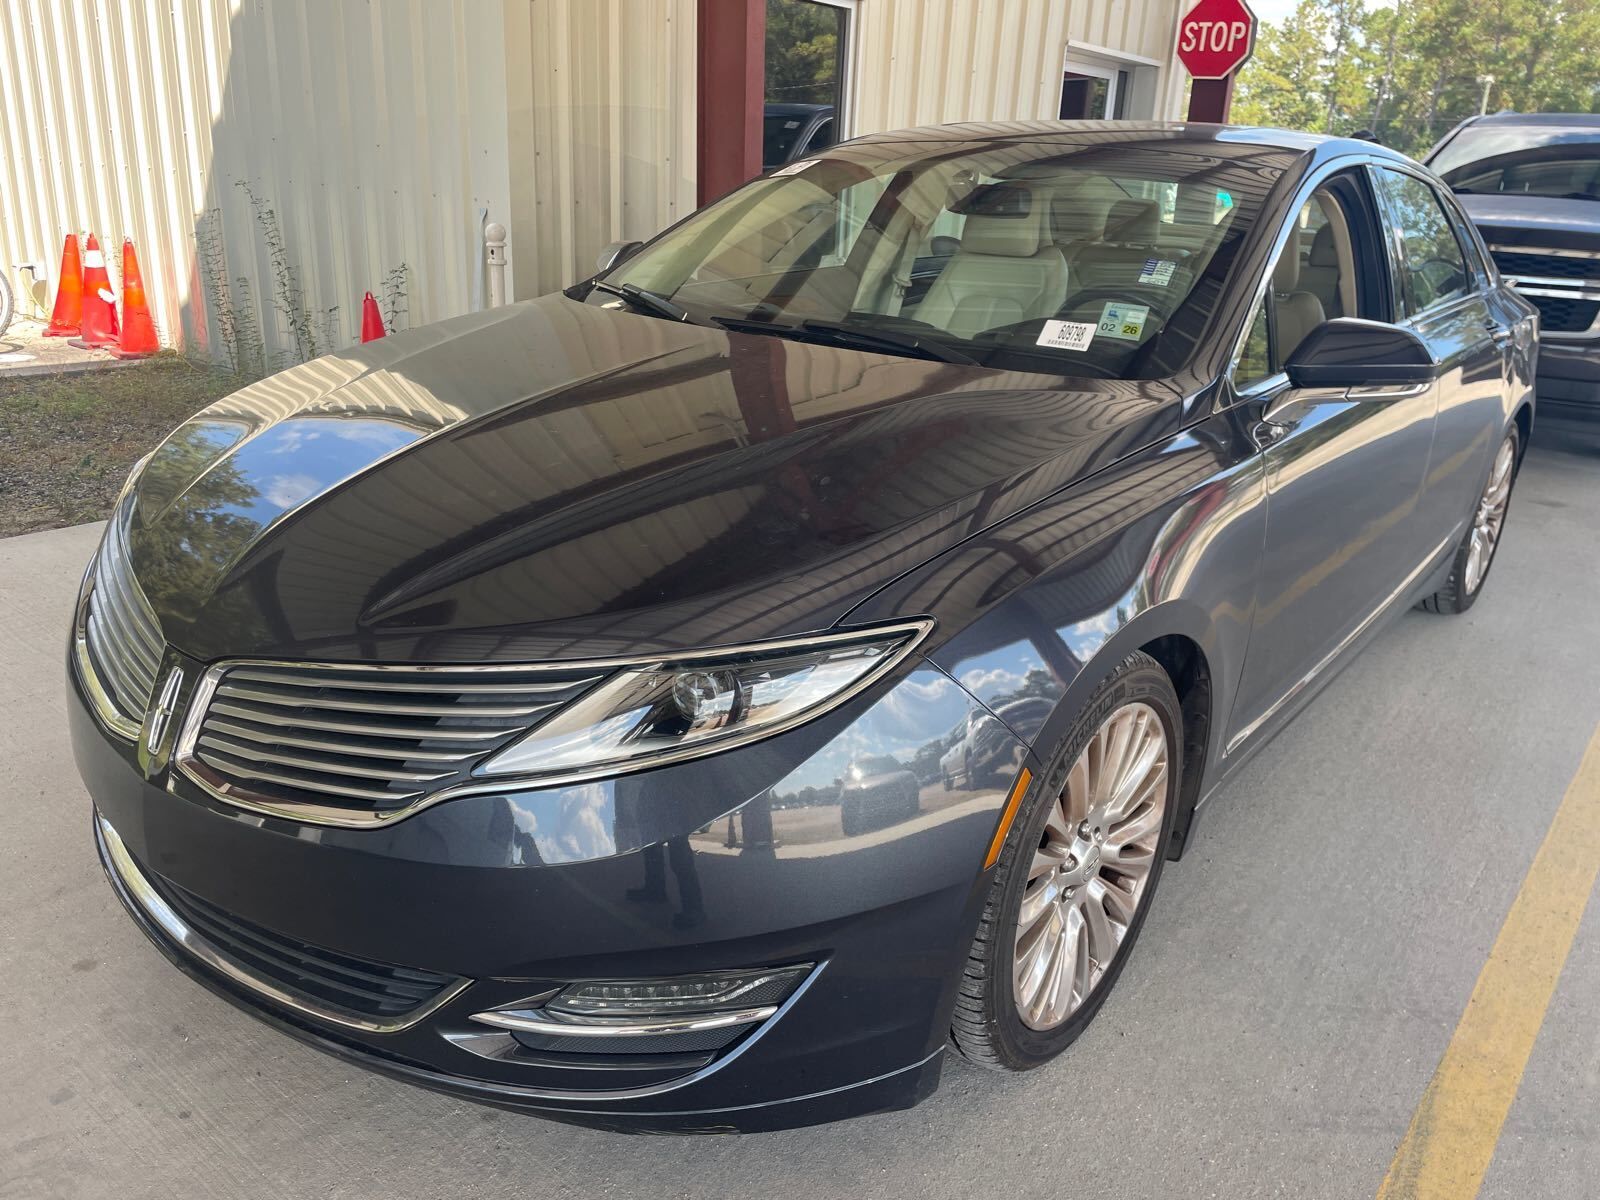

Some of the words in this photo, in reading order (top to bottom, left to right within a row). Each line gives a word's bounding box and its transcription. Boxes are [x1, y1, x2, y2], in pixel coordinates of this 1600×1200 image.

[1181, 21, 1247, 52] STOP
[1058, 325, 1087, 342] 609798
[1101, 322, 1116, 332] 02
[1123, 325, 1138, 335] 26
